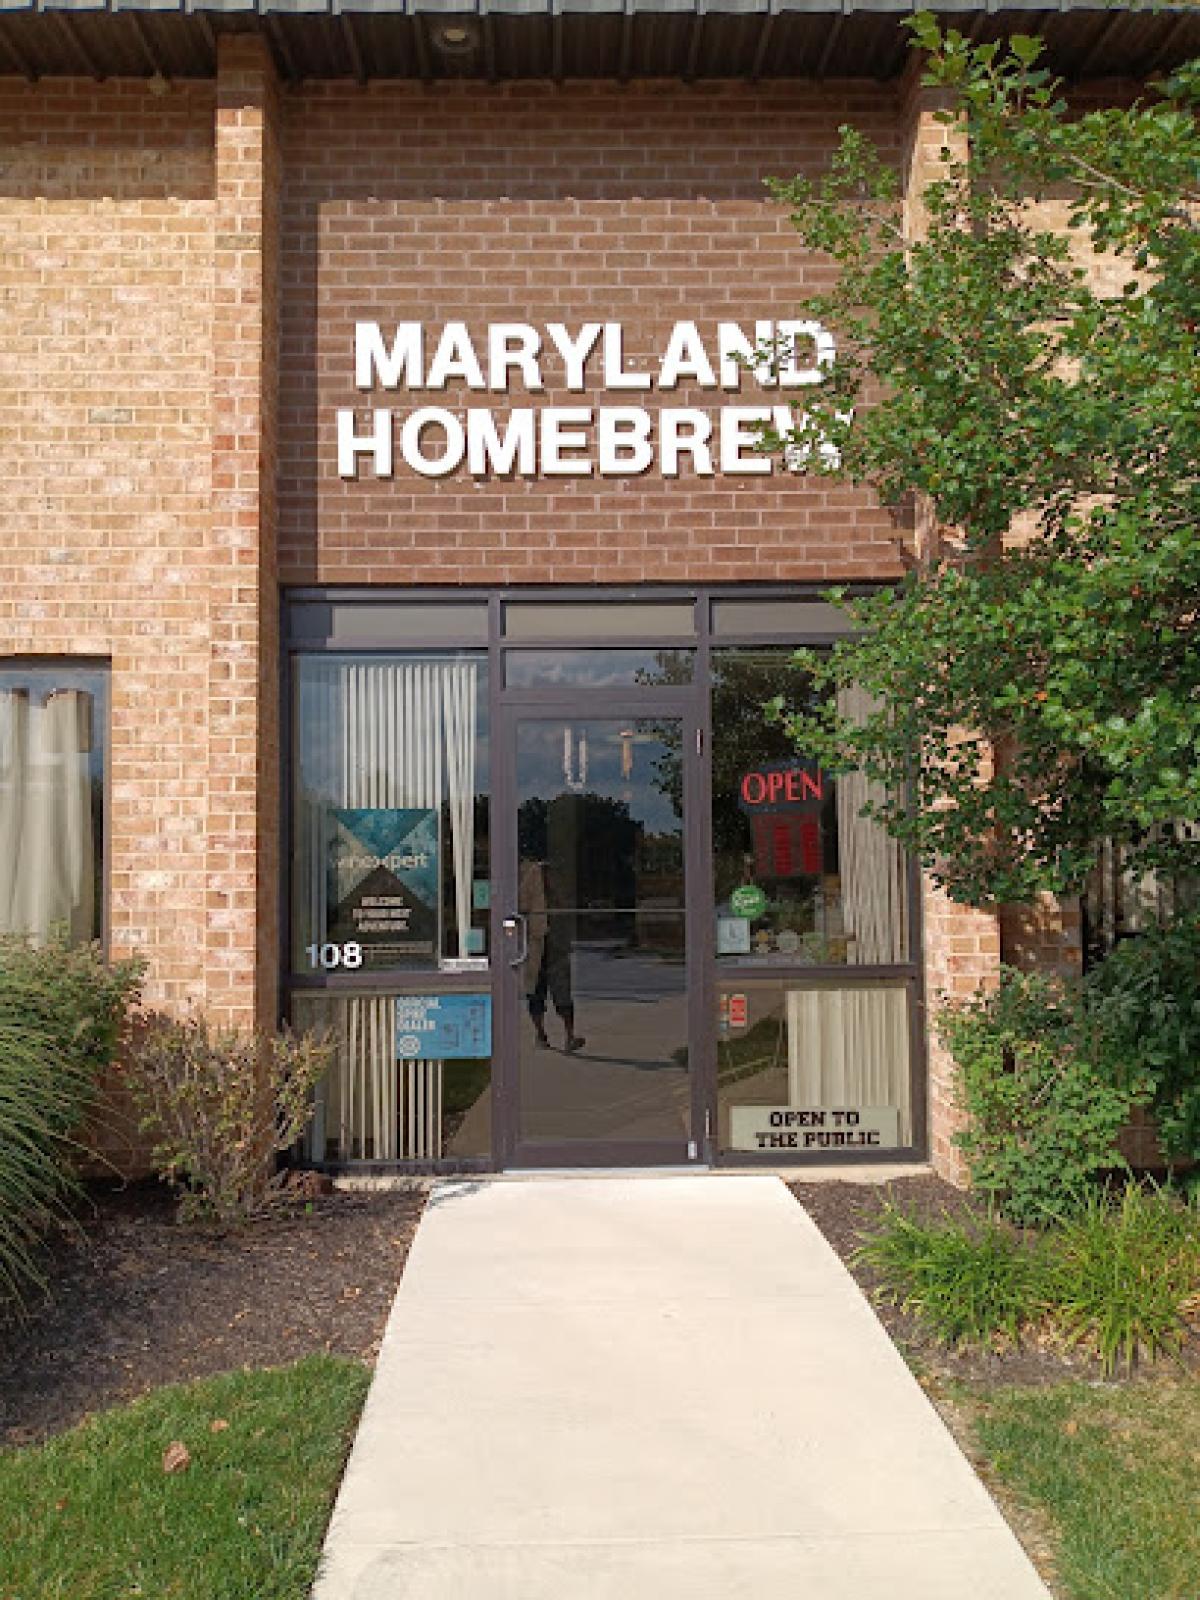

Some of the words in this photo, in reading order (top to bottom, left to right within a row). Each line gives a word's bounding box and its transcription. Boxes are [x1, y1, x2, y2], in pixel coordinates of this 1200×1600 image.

[354, 319, 836, 389] MARYLAND
[740, 768, 824, 804] OPEN
[305, 940, 363, 969] 108
[769, 1111, 827, 1127] OPEN
[831, 1111, 860, 1127] TO
[755, 1132, 798, 1148] THE
[802, 1131, 881, 1148] PUBLIC
